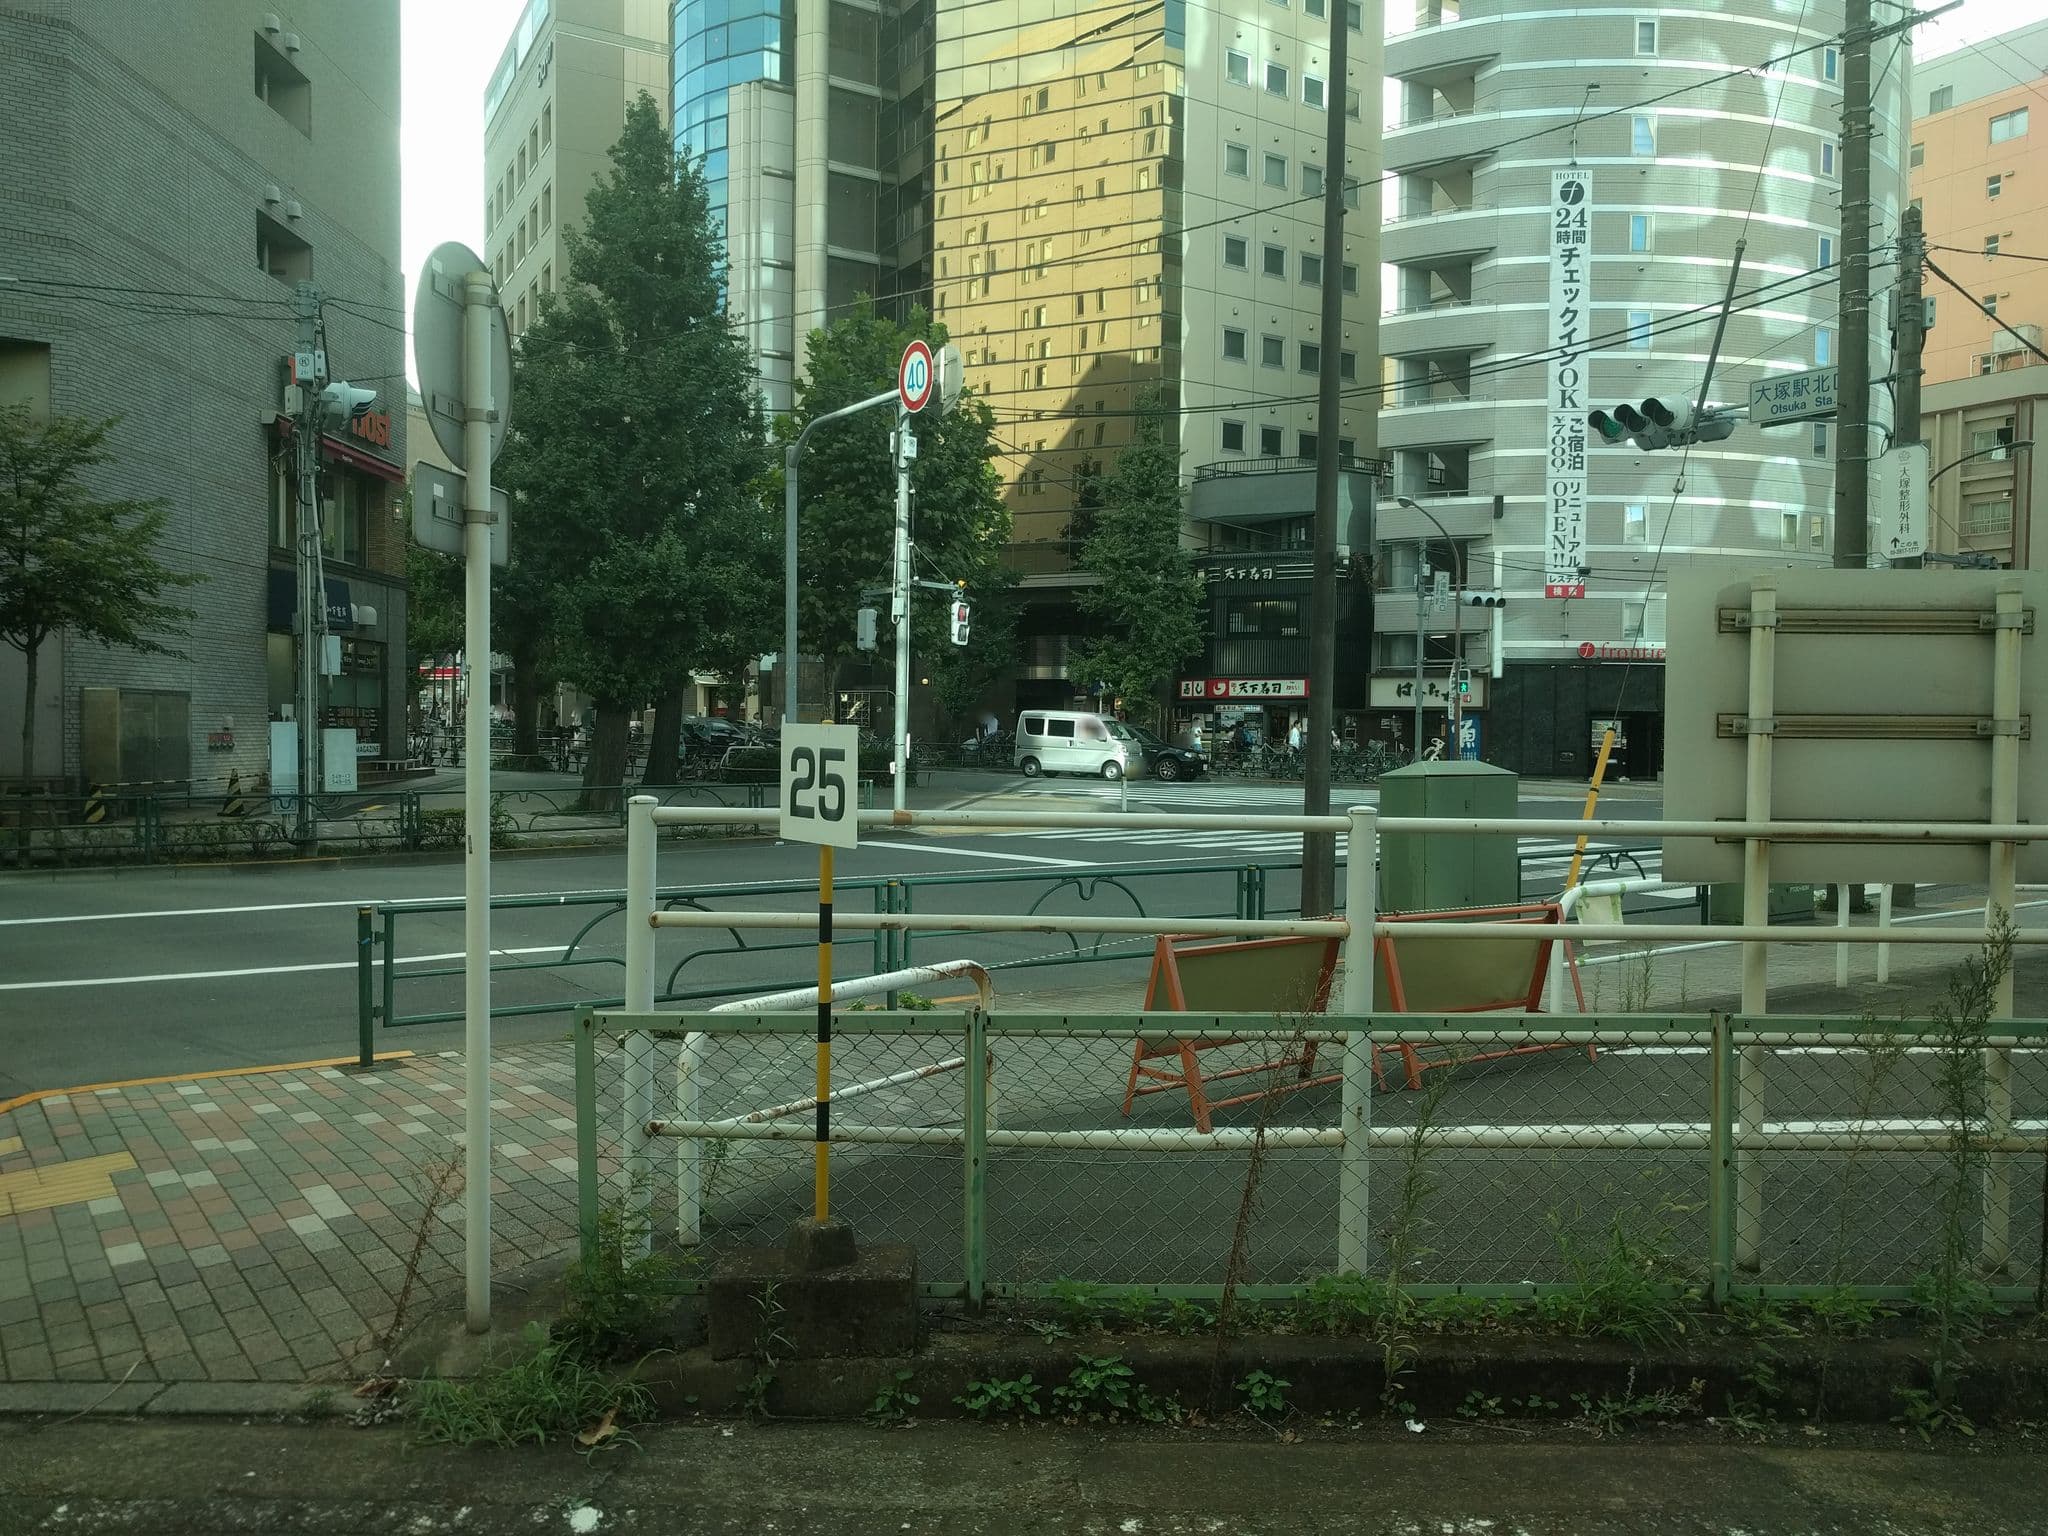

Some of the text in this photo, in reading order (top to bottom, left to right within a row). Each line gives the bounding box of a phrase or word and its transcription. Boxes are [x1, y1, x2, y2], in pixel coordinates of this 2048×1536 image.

[1556, 172, 1589, 180] HOTEL
[1555, 207, 1588, 228] 24
[1556, 230, 1586, 244] 時間
[907, 360, 925, 392] 40
[1771, 396, 1836, 415] Otsuka Sta.
[1568, 418, 1585, 470] ご宿泊
[1552, 481, 1568, 568] OPEN!!
[1568, 482, 1581, 567] リニューアル
[790, 746, 846, 822] 25
